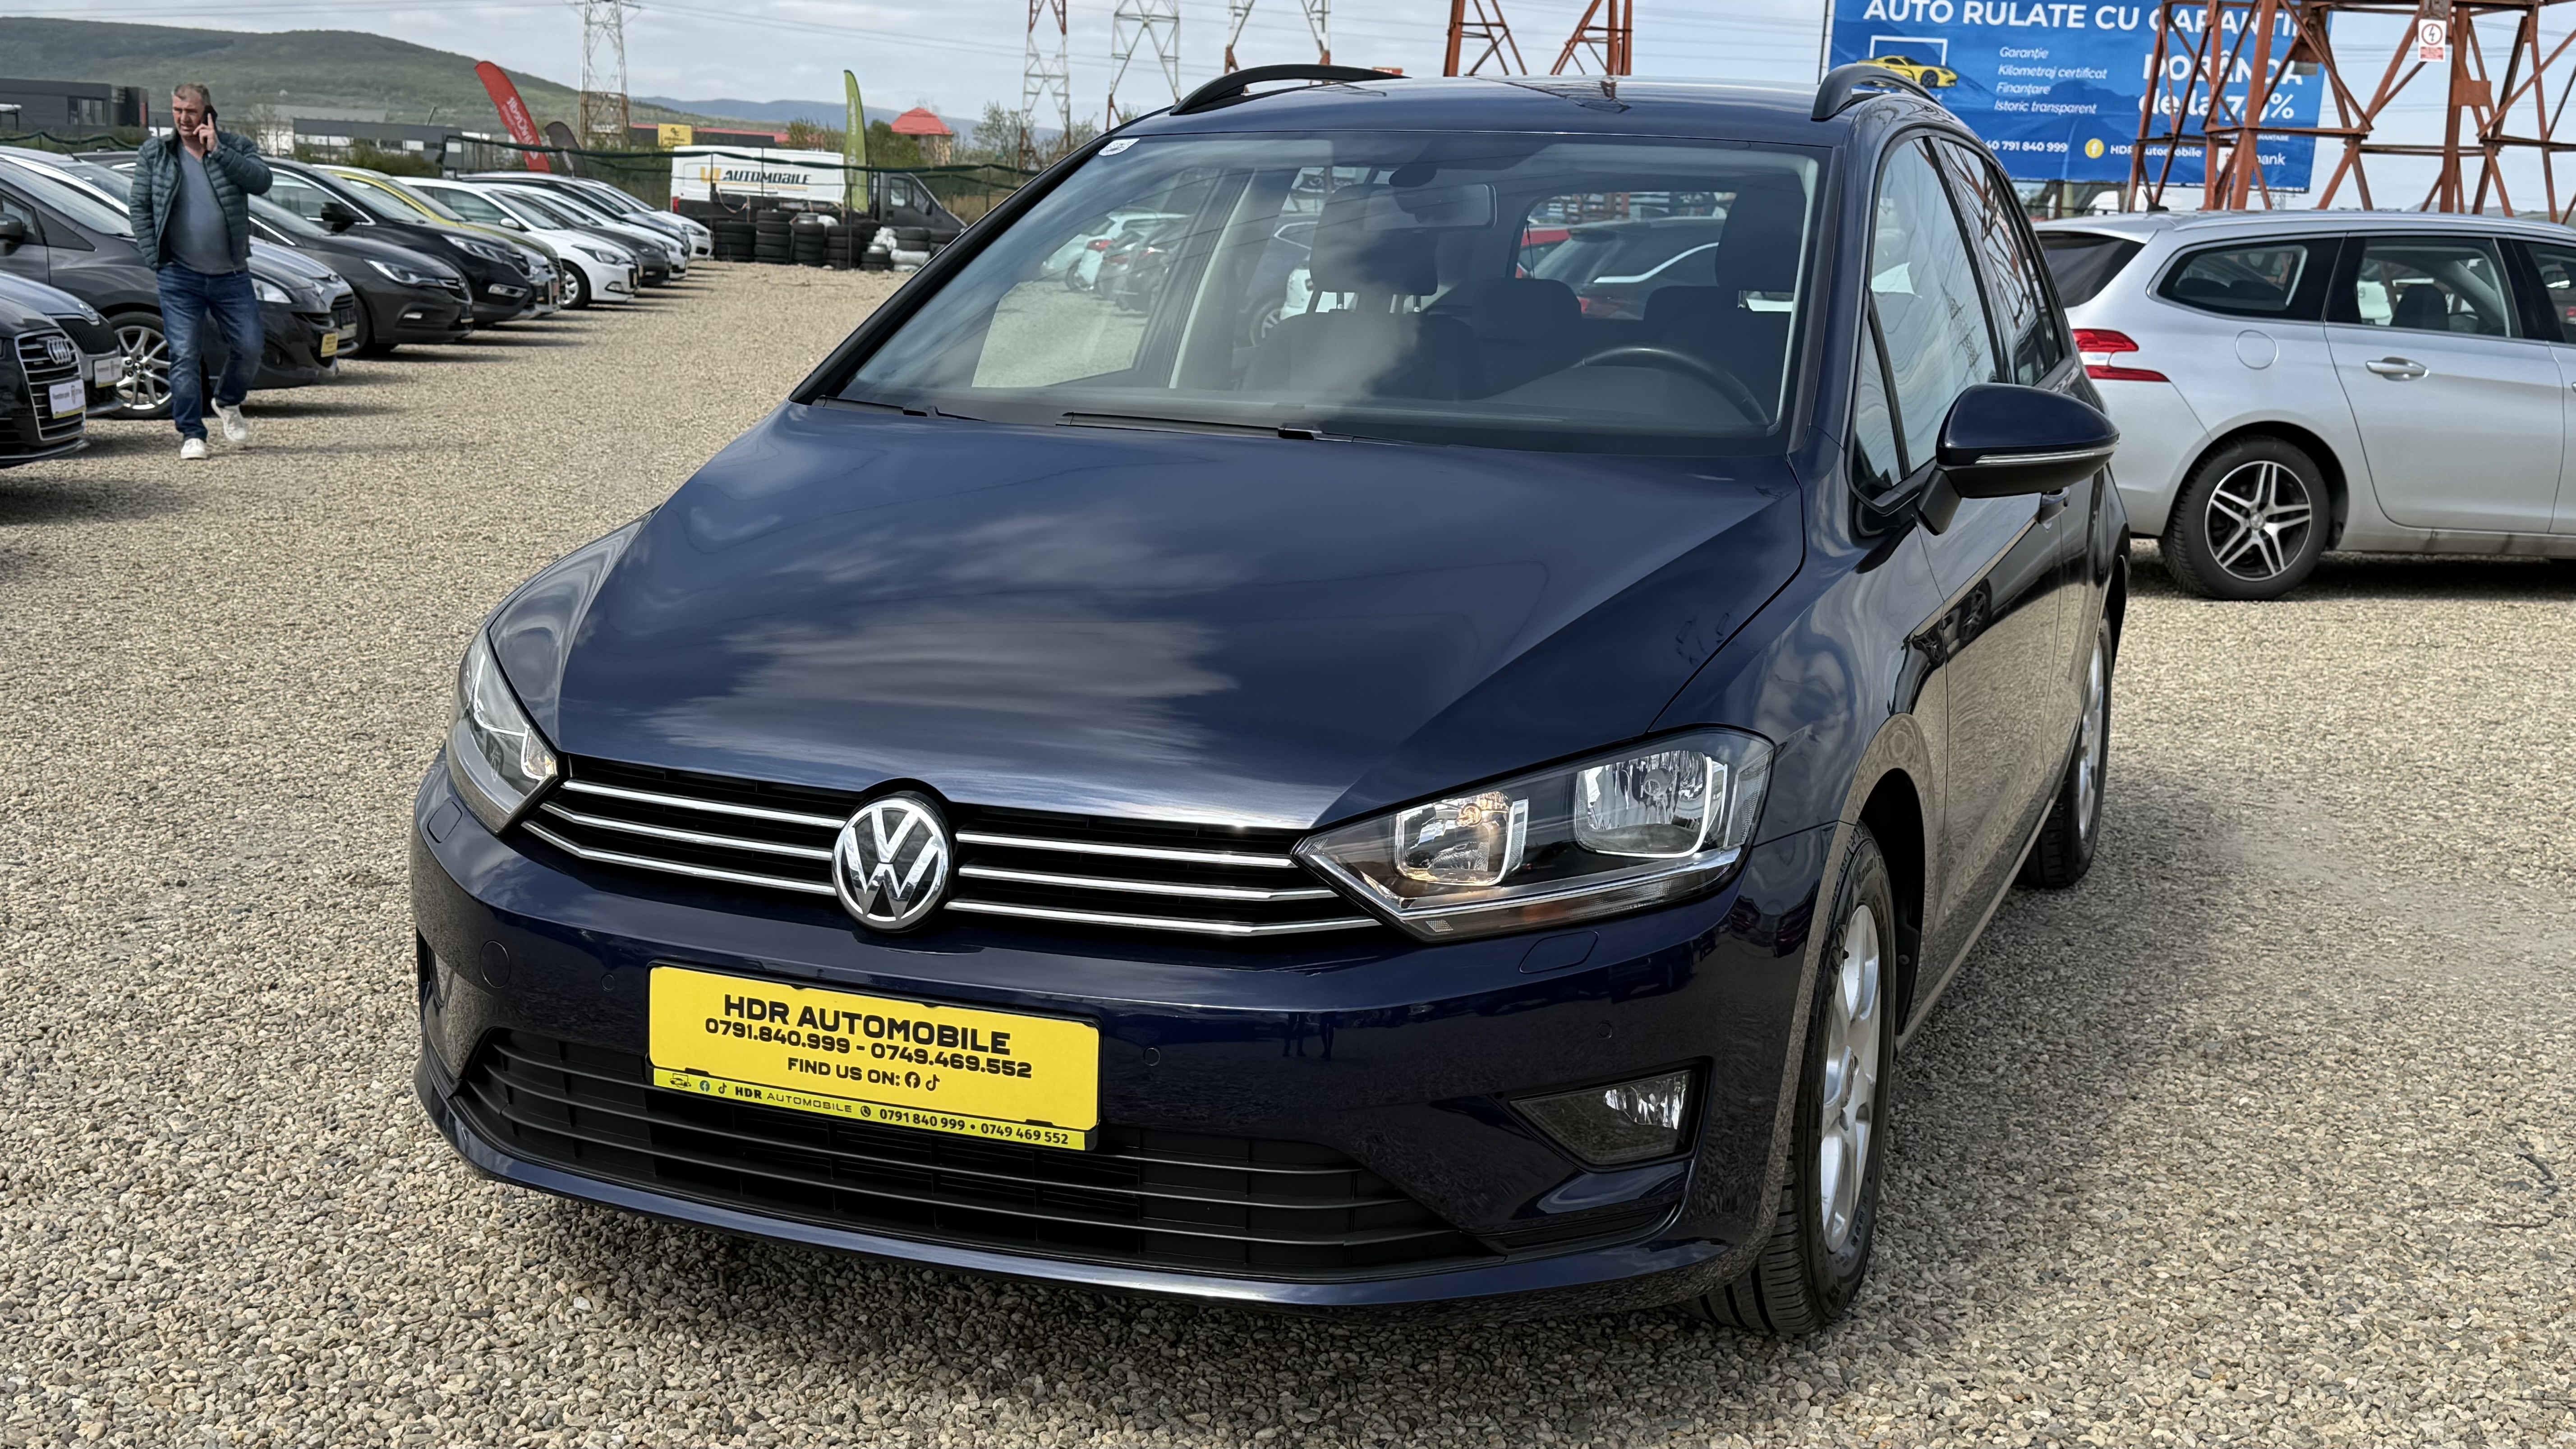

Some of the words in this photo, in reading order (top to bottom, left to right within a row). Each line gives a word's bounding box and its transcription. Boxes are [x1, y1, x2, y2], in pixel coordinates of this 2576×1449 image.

[1863, 0, 1954, 23] AUTO
[1963, 1, 2087, 28] RULATE
[2095, 5, 2140, 31] CU
[2000, 46, 2049, 60] Garanție
[1998, 64, 2057, 79] Kilometraj
[2058, 67, 2107, 79] certificat
[1996, 82, 2051, 95] Finanțare
[1994, 100, 2029, 112] Istoric
[2031, 101, 2098, 115] transparent
[2139, 88, 2180, 115] de
[2188, 89, 2210, 116] la
[2001, 141, 2020, 151] 791
[2022, 141, 2045, 152] 840
[2047, 142, 2068, 152] 999
[2144, 147, 2202, 157] utomobile
[723, 170, 811, 184] AUTOMOBILE
[724, 994, 790, 1026] HDR
[797, 1005, 1011, 1056] AUTOMOBILE
[705, 1017, 851, 1054] 0791.840.999
[871, 1043, 1032, 1079] 0749.469.552
[788, 1057, 831, 1076] FIND
[836, 1064, 863, 1081] US
[867, 1069, 900, 1086] ON:
[735, 1086, 763, 1099] HDR
[767, 1092, 852, 1113] AUTOMOBILE
[879, 1109, 910, 1123] 0791
[912, 1113, 938, 1127] 840
[940, 1117, 965, 1131] 999
[980, 1122, 1013, 1137] 0749
[1016, 1127, 1041, 1141] 469
[1044, 1131, 1069, 1145] 552
